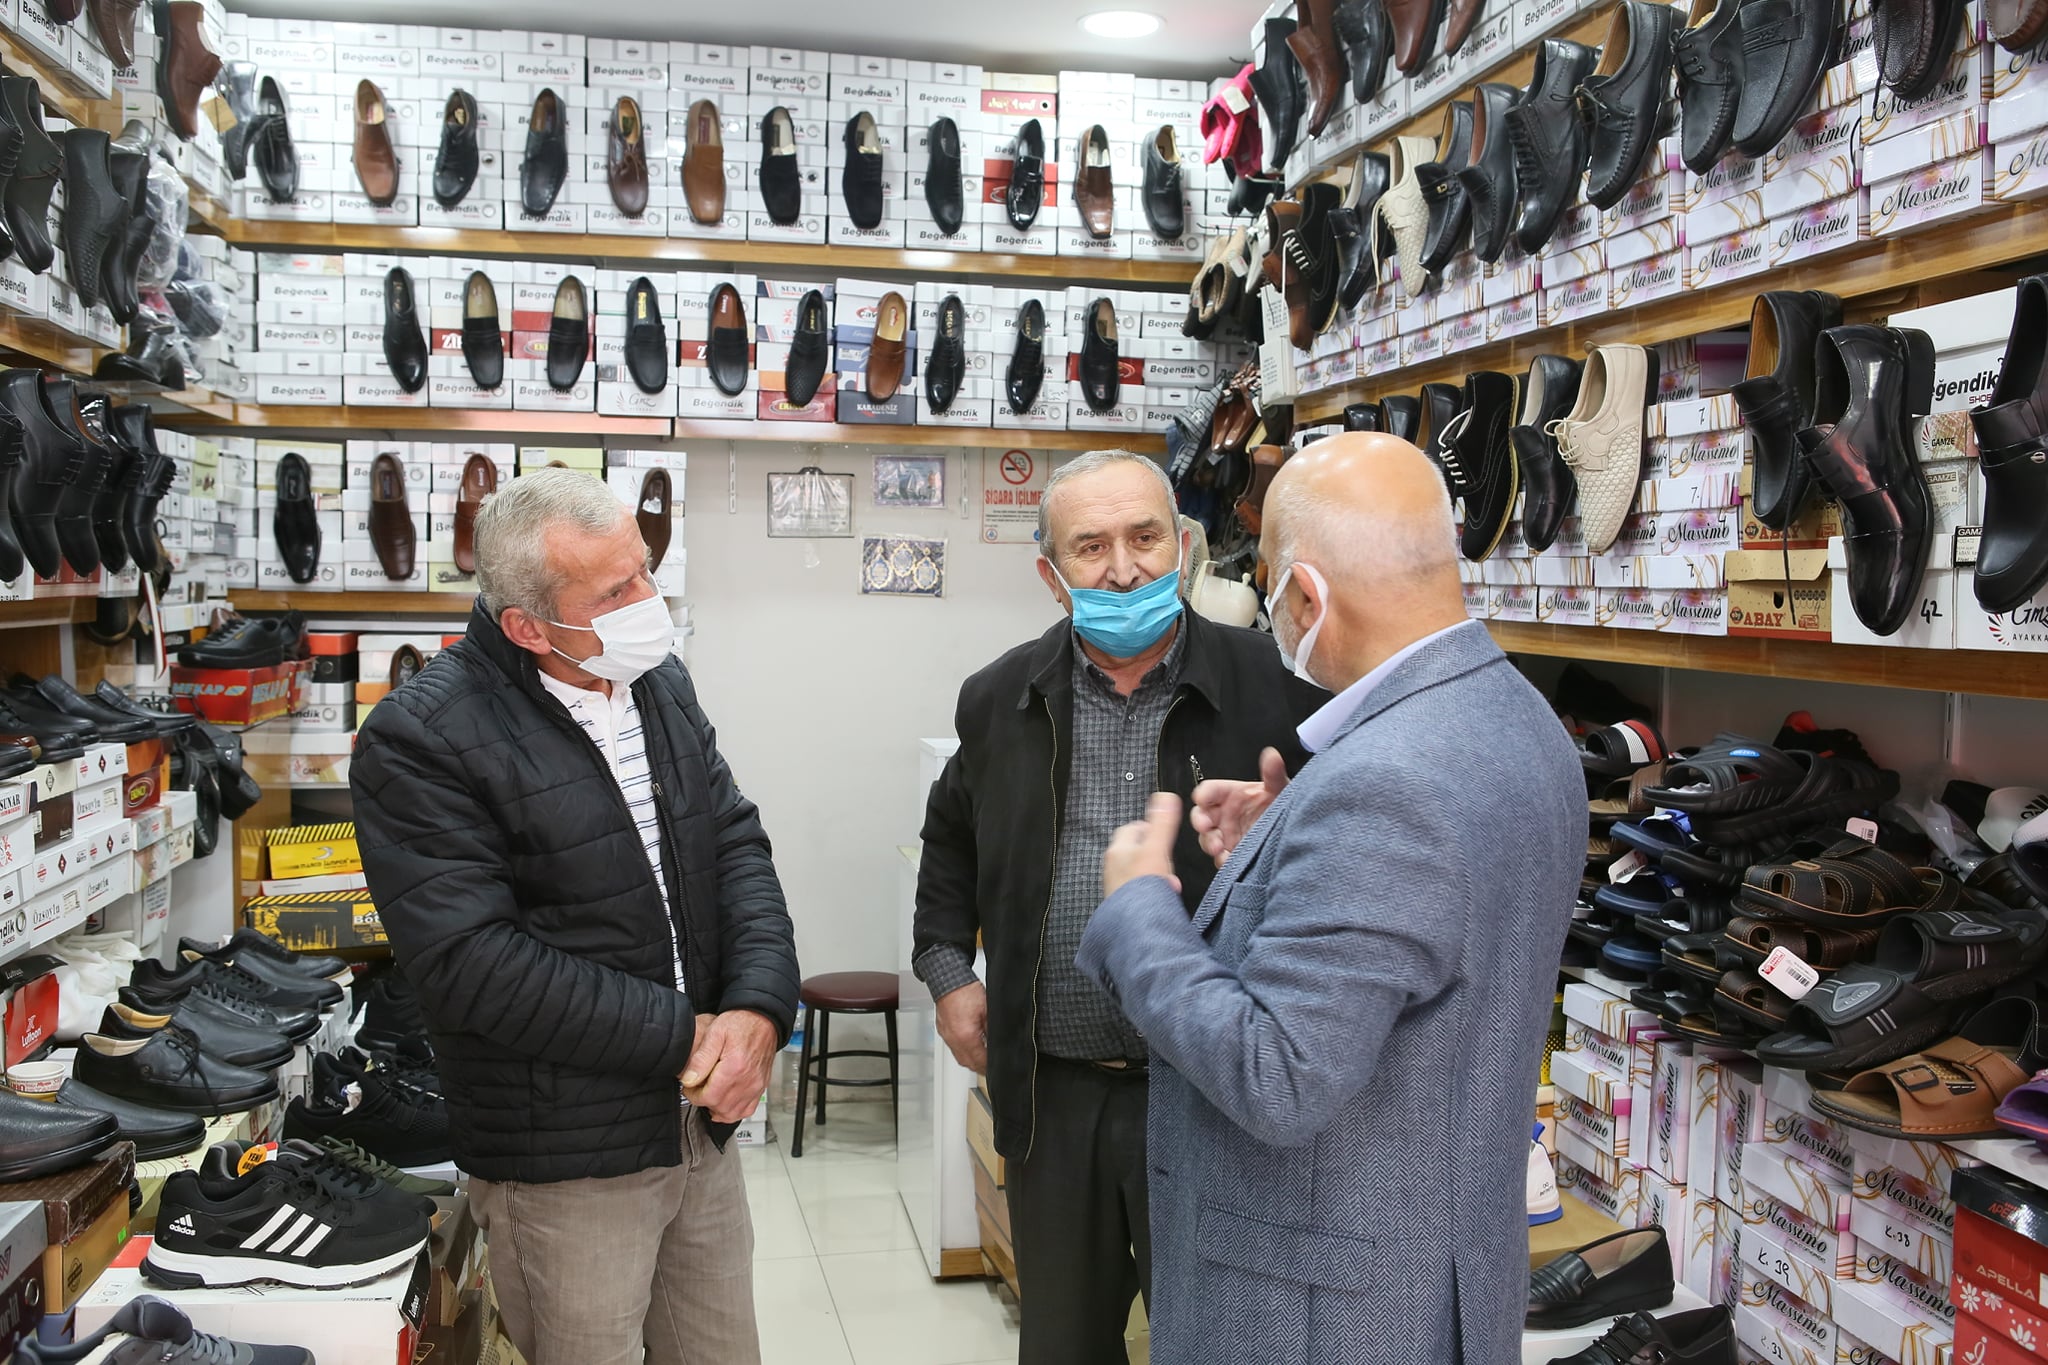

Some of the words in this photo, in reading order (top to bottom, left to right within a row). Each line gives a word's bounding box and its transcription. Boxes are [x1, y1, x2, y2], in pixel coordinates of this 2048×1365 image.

[1694, 159, 1755, 196] Massimo
[1610, 193, 1663, 222] Massimo
[1881, 175, 1970, 216] Massimo
[1779, 213, 1849, 248] Massimo
[1699, 242, 1761, 274] Massimo
[1553, 280, 1602, 311] Massimo
[1621, 265, 1676, 293] Massimo
[1933, 370, 2000, 401] ğendik
[1680, 443, 1737, 465] Massimo
[1931, 437, 1955, 448] GAMZE
[1016, 488, 1044, 508] İÇİLME
[1668, 523, 1729, 544] Massimo
[1494, 592, 1533, 611] Massimo
[1546, 593, 1590, 612] Massimo
[1920, 598, 1943, 624] 42
[1744, 611, 1784, 628] ABAY
[1573, 1030, 1624, 1067] Massimo
[1560, 1096, 1608, 1139] Massimo
[1660, 1062, 1674, 1165] Massimo
[1728, 1089, 1748, 1195] Massimo
[1776, 1116, 1852, 1168] Massimo
[1565, 1167, 1618, 1210] Massimo
[1865, 1168, 1953, 1229] Massimo
[169, 1224, 196, 1237] adidas
[1753, 1199, 1828, 1255] Massimo
[1866, 1254, 1957, 1320] Massimo
[1976, 1263, 2037, 1302] APELLA
[1753, 1281, 1828, 1341] Massimo
